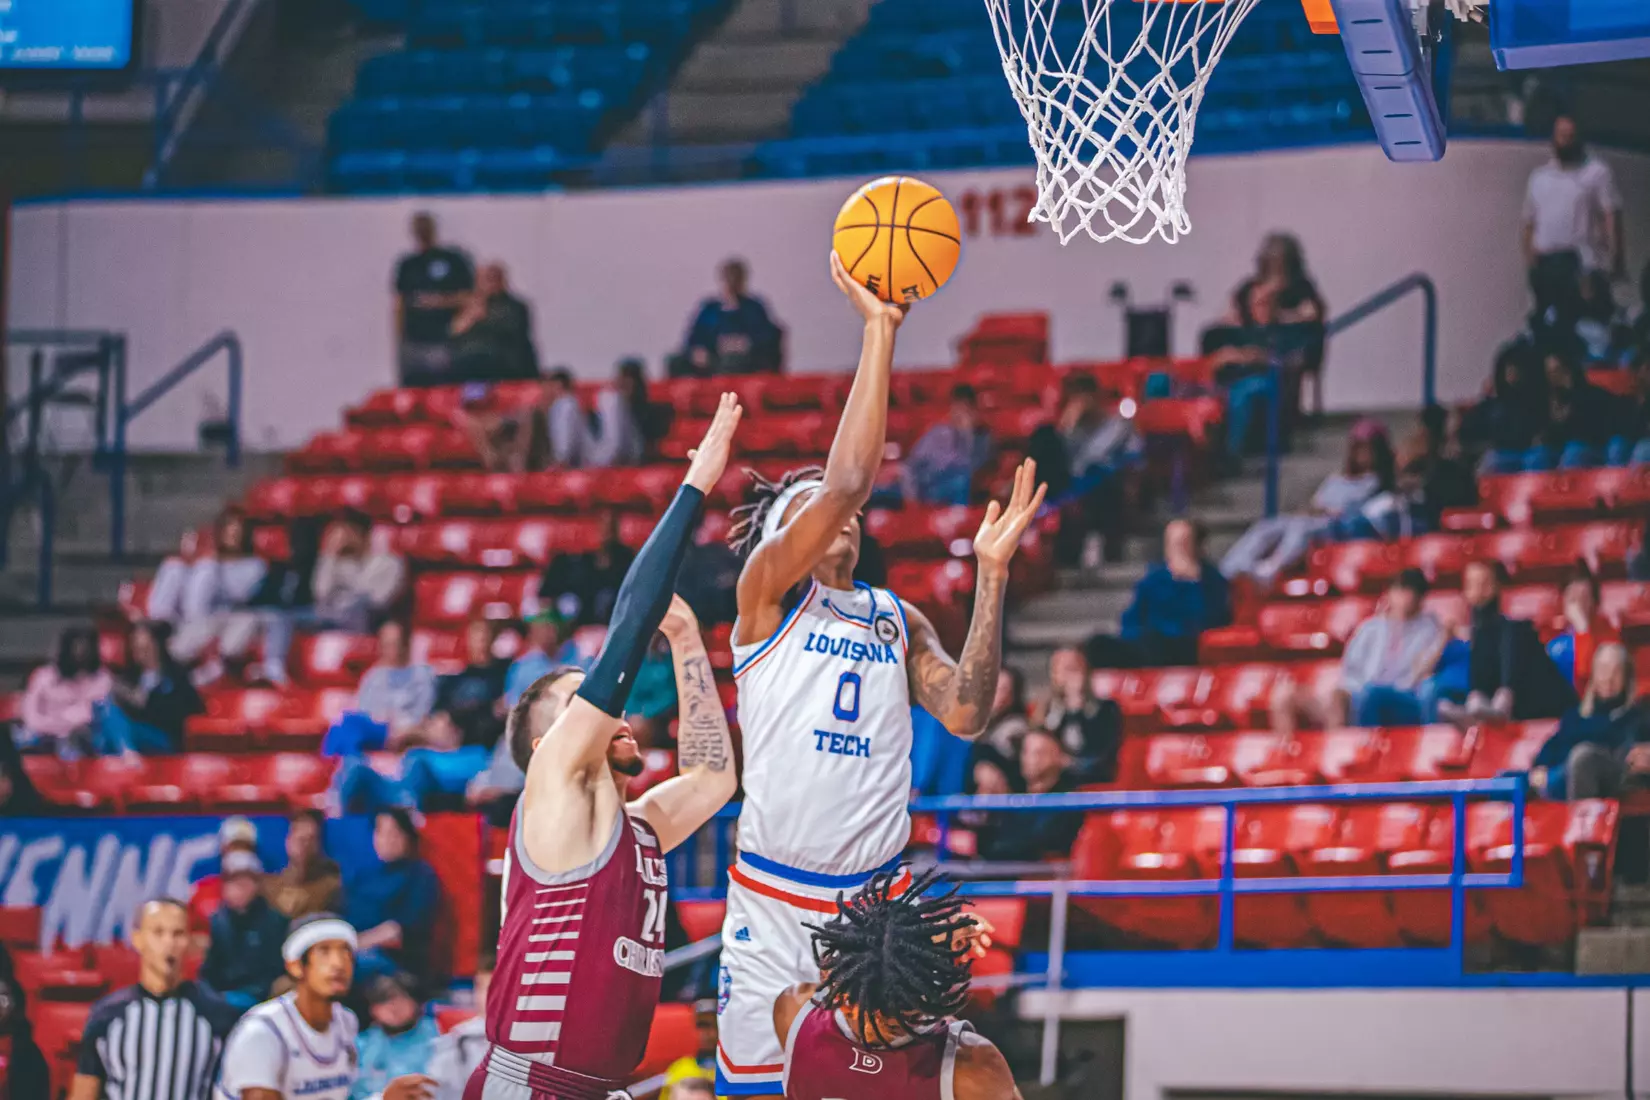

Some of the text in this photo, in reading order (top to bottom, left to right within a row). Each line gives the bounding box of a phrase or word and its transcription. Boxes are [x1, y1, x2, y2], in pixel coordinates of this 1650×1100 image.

[962, 186, 1038, 236] 112
[832, 671, 861, 723] 0
[813, 729, 871, 758] TECH
